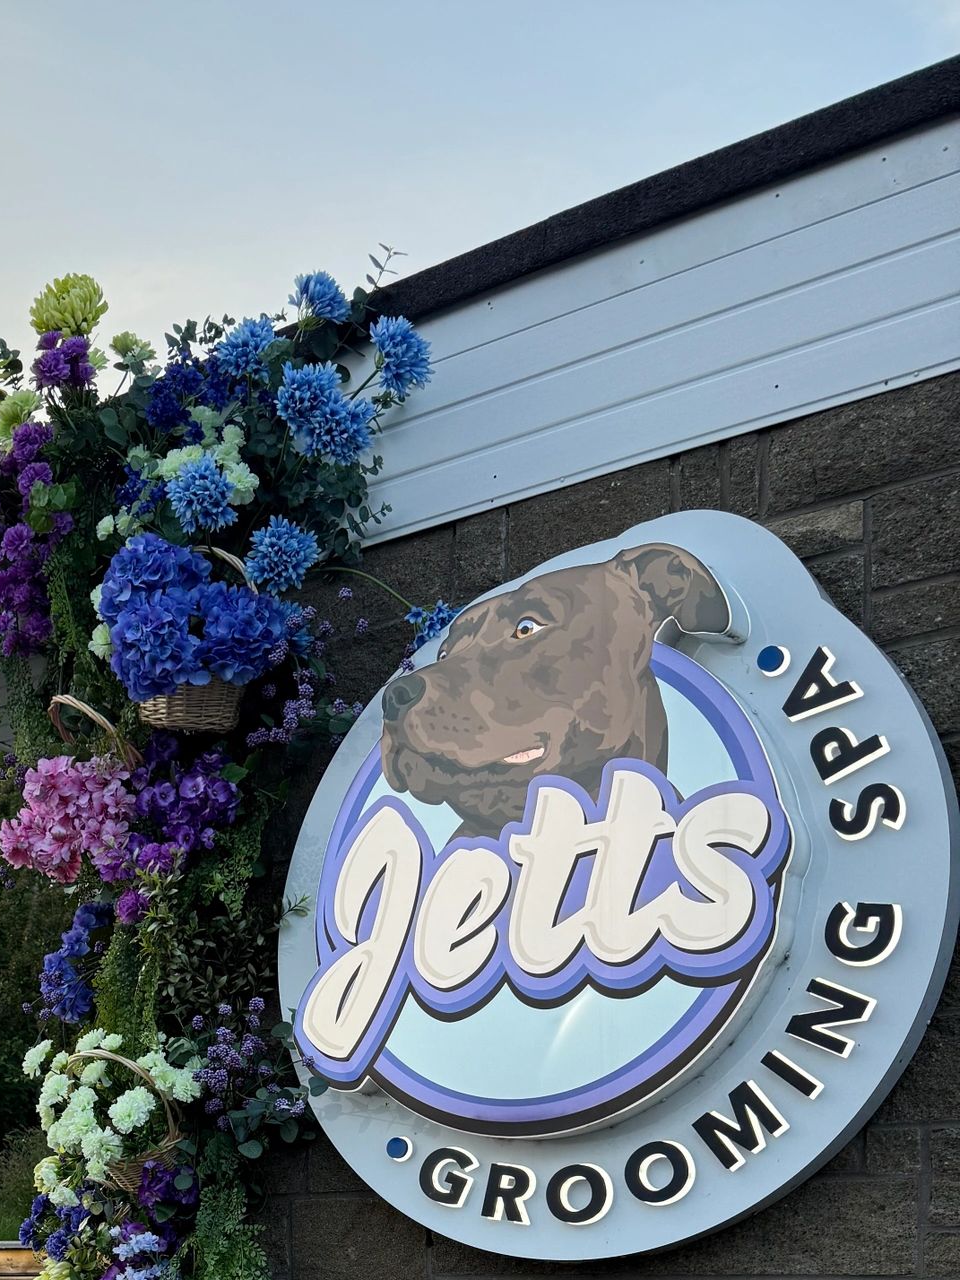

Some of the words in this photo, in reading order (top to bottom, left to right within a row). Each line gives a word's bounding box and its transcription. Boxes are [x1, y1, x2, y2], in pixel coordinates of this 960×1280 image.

[302, 769, 772, 1060] Jetts
[418, 901, 904, 1226] GROOMING
[782, 645, 907, 843] SPA
